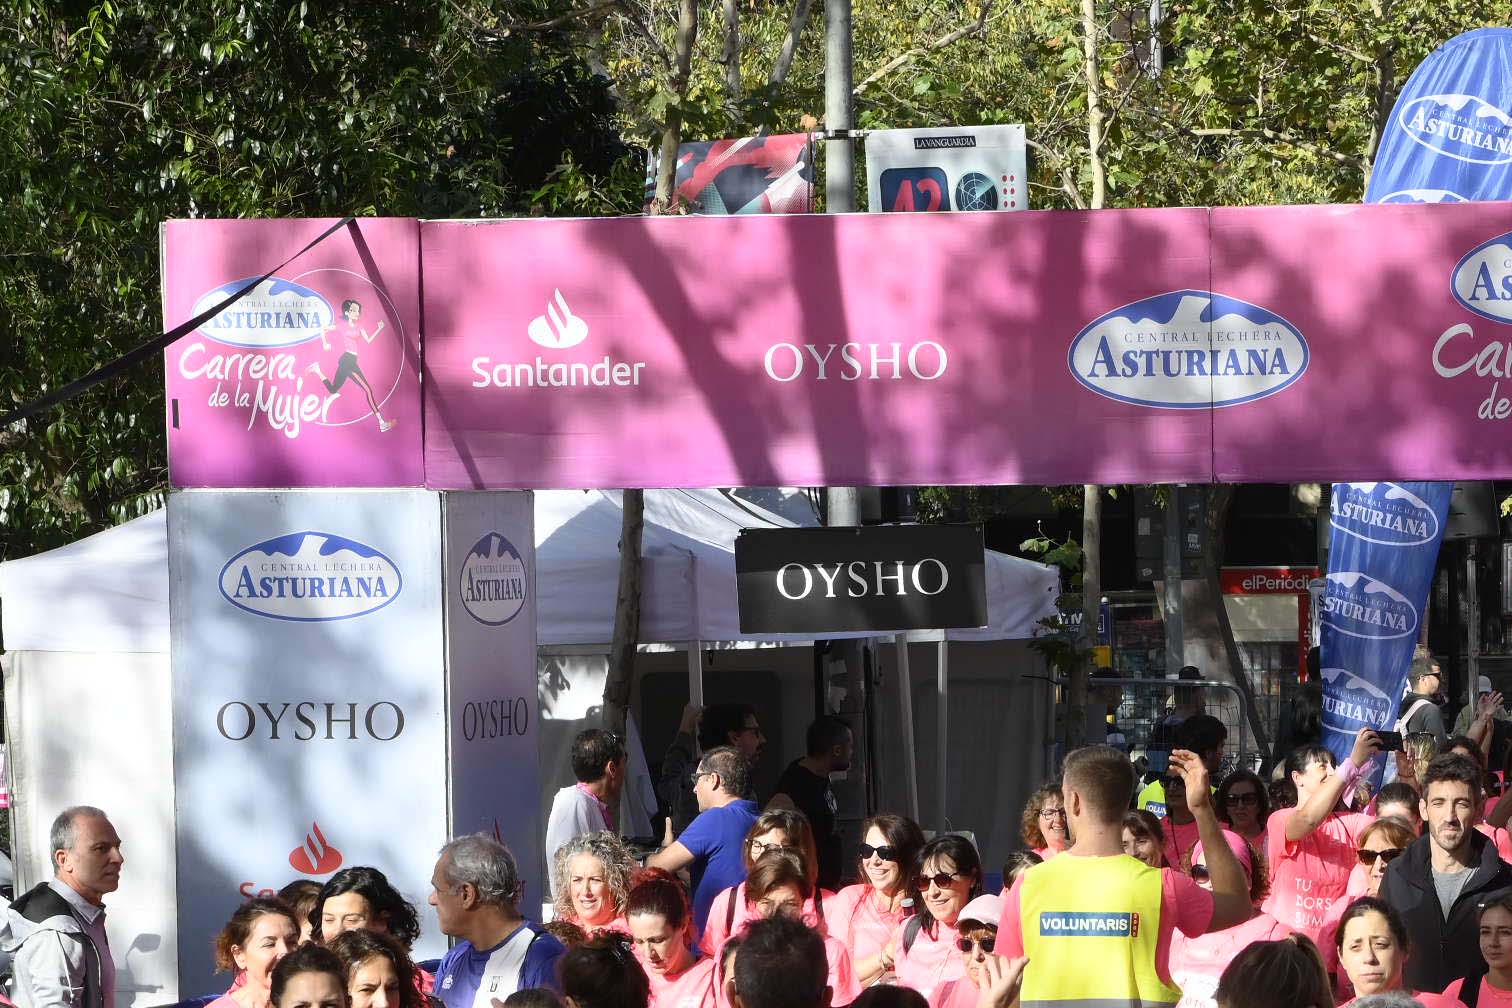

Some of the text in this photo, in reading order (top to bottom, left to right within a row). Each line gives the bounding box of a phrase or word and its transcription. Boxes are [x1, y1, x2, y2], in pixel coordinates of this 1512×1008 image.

[1123, 329, 1283, 344] CENTRAL LECHERA
[179, 343, 296, 381] Carrera
[472, 355, 646, 388] Santander
[764, 340, 949, 384] OYSHO
[1087, 334, 1291, 379] ASTURIANA
[208, 377, 341, 439] de la Mujer
[1478, 384, 1512, 421] de
[1330, 490, 1428, 538] ASTURIANA
[232, 565, 389, 599] ASTURIANA
[261, 561, 383, 573] CENTRAL LECHERA
[465, 567, 524, 602] ASTURIANA
[776, 557, 950, 600] OYSHO
[1323, 596, 1408, 632] STURIANA
[216, 700, 406, 742] OYSHO
[462, 697, 529, 743] OYSHO
[1295, 877, 1313, 892] TU
[1041, 916, 1128, 934] VOLUNTARIS
